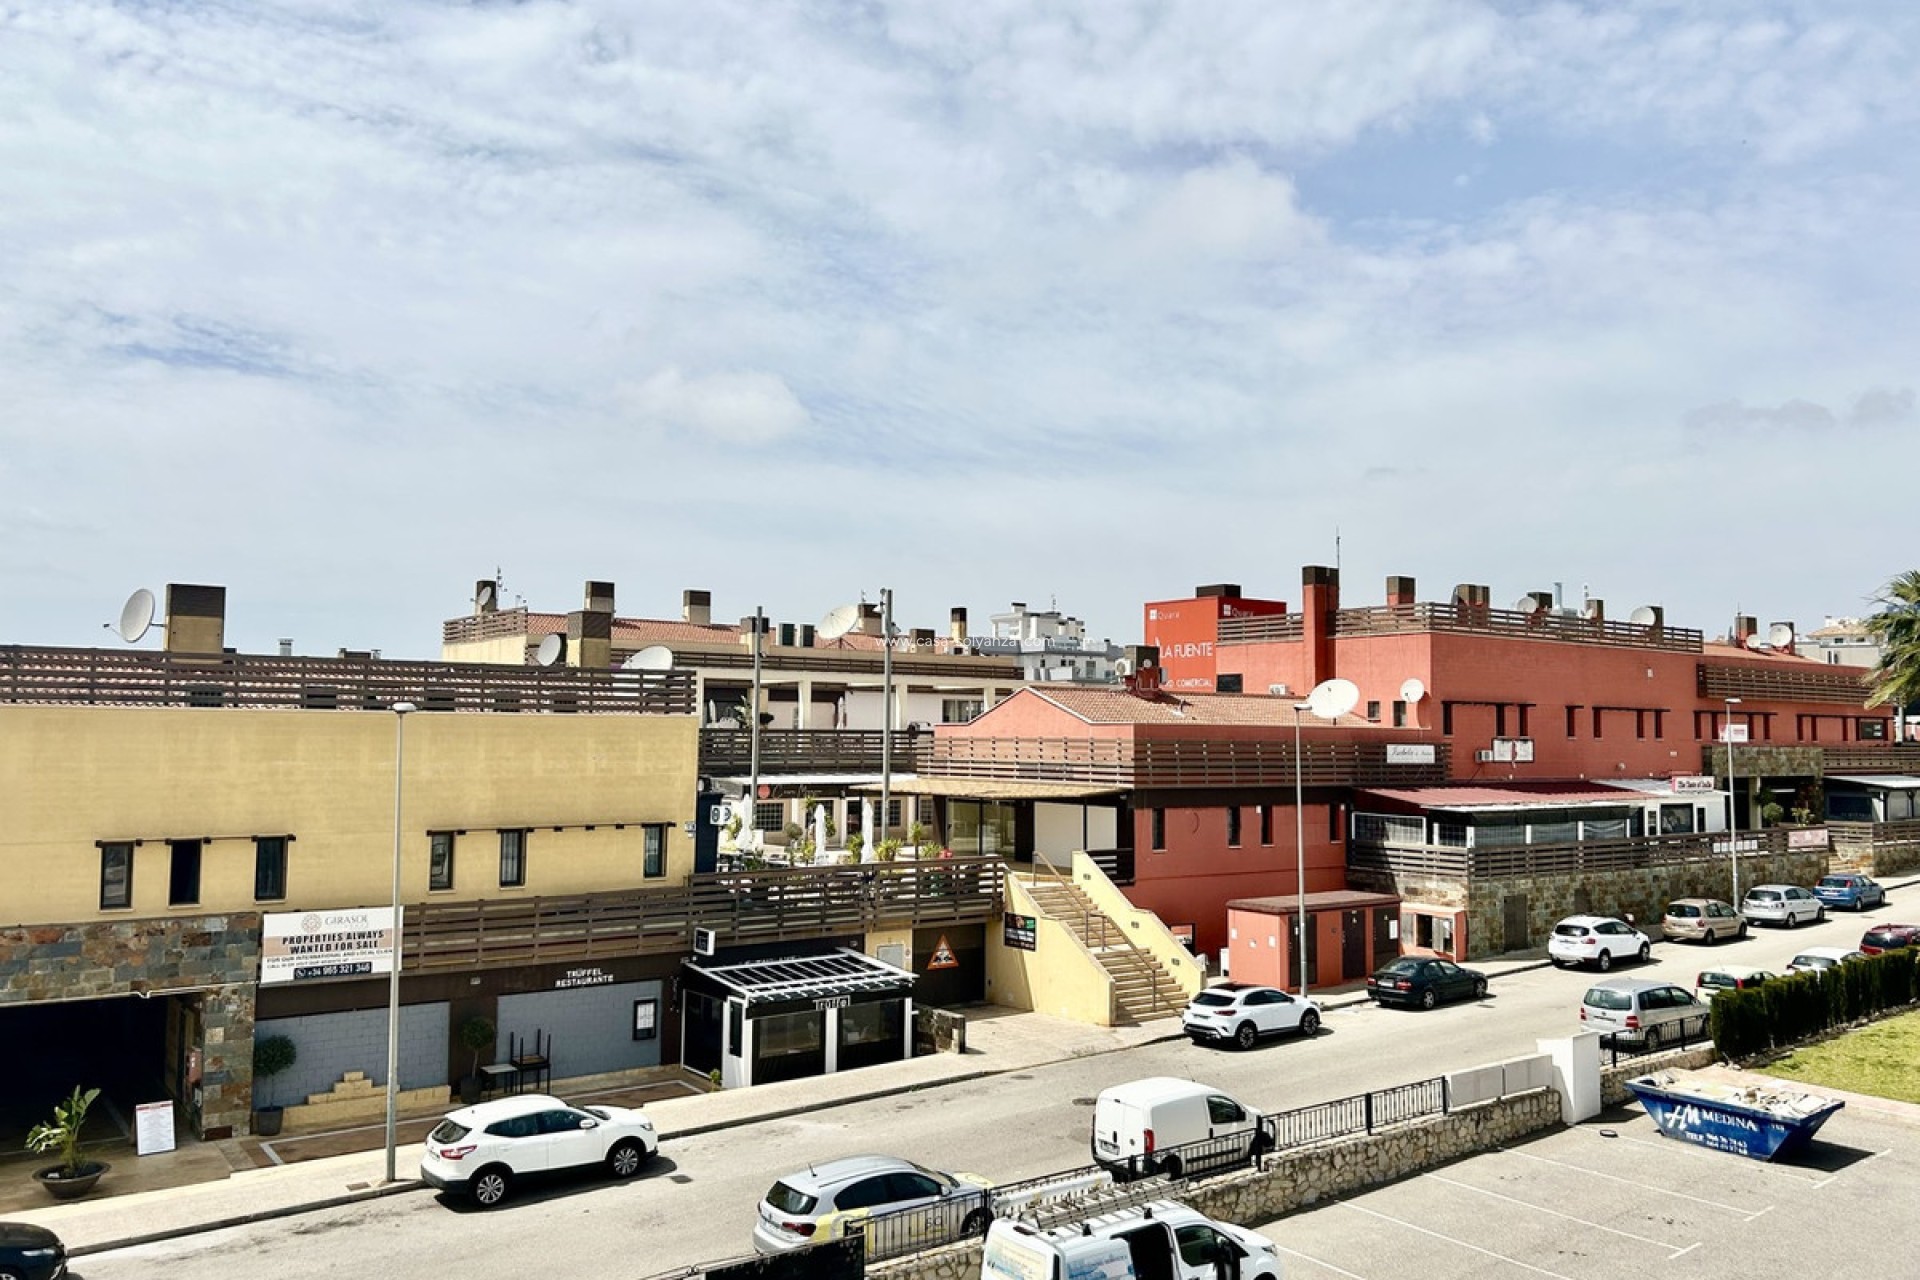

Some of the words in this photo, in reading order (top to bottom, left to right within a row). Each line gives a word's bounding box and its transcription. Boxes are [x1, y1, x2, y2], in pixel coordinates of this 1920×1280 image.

[1174, 641, 1213, 658] FUENTE
[283, 932, 343, 944] PROPERTIES
[346, 930, 385, 940] ALWAYS
[289, 943, 332, 954] WANTED
[335, 941, 353, 951] FOR
[356, 940, 379, 949] SALE
[555, 975, 613, 987] RESTAURANTE
[1702, 1109, 1758, 1131] MEDINA
